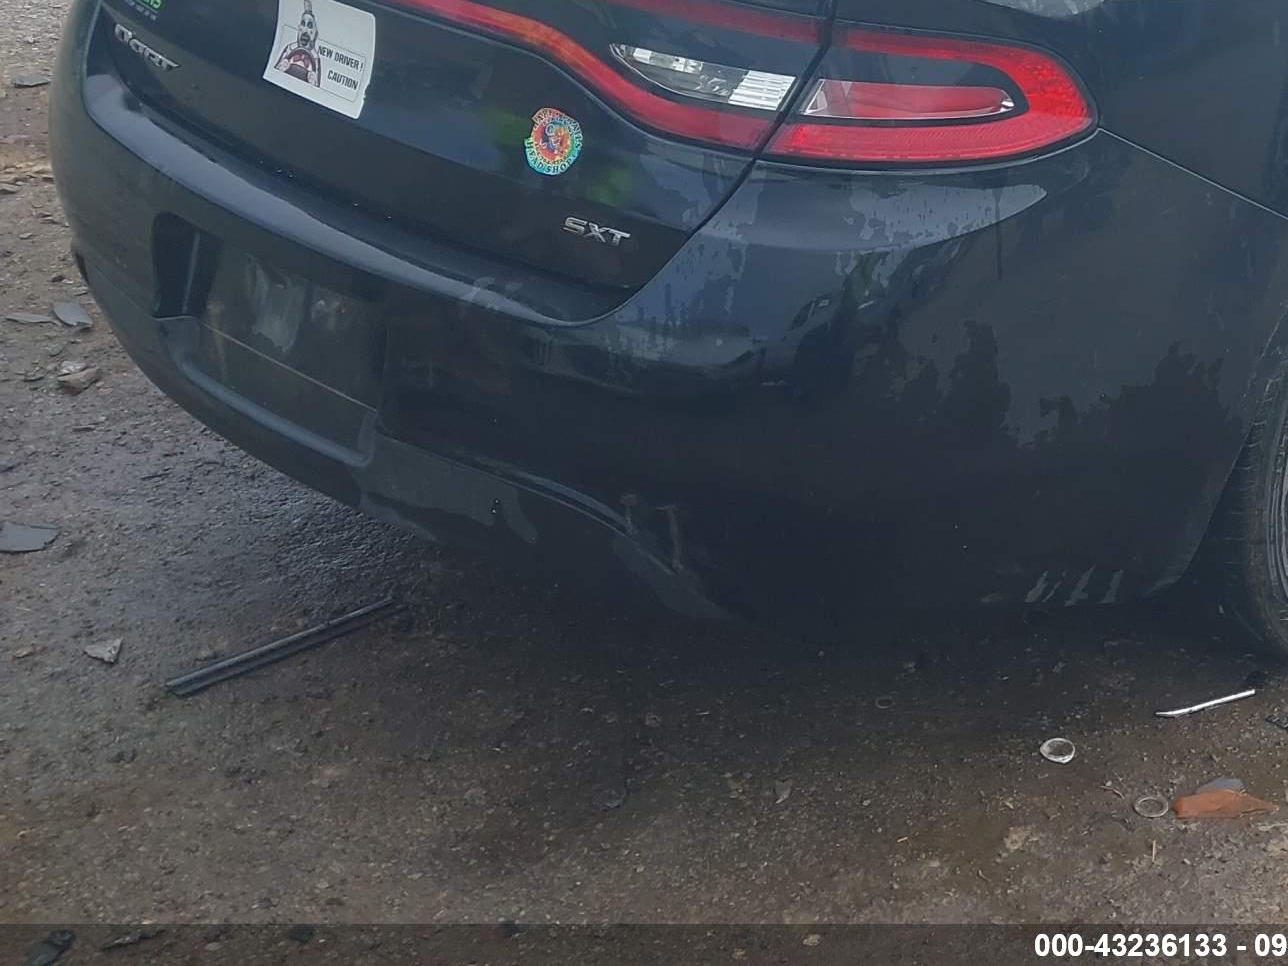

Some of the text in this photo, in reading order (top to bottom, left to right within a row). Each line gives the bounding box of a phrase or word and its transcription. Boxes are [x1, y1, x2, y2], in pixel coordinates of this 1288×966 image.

[319, 46, 333, 58] NEW
[334, 52, 359, 70] DRIVER
[327, 70, 358, 90] CAUTION
[544, 156, 574, 174] SHOP
[562, 216, 631, 246] SXT
